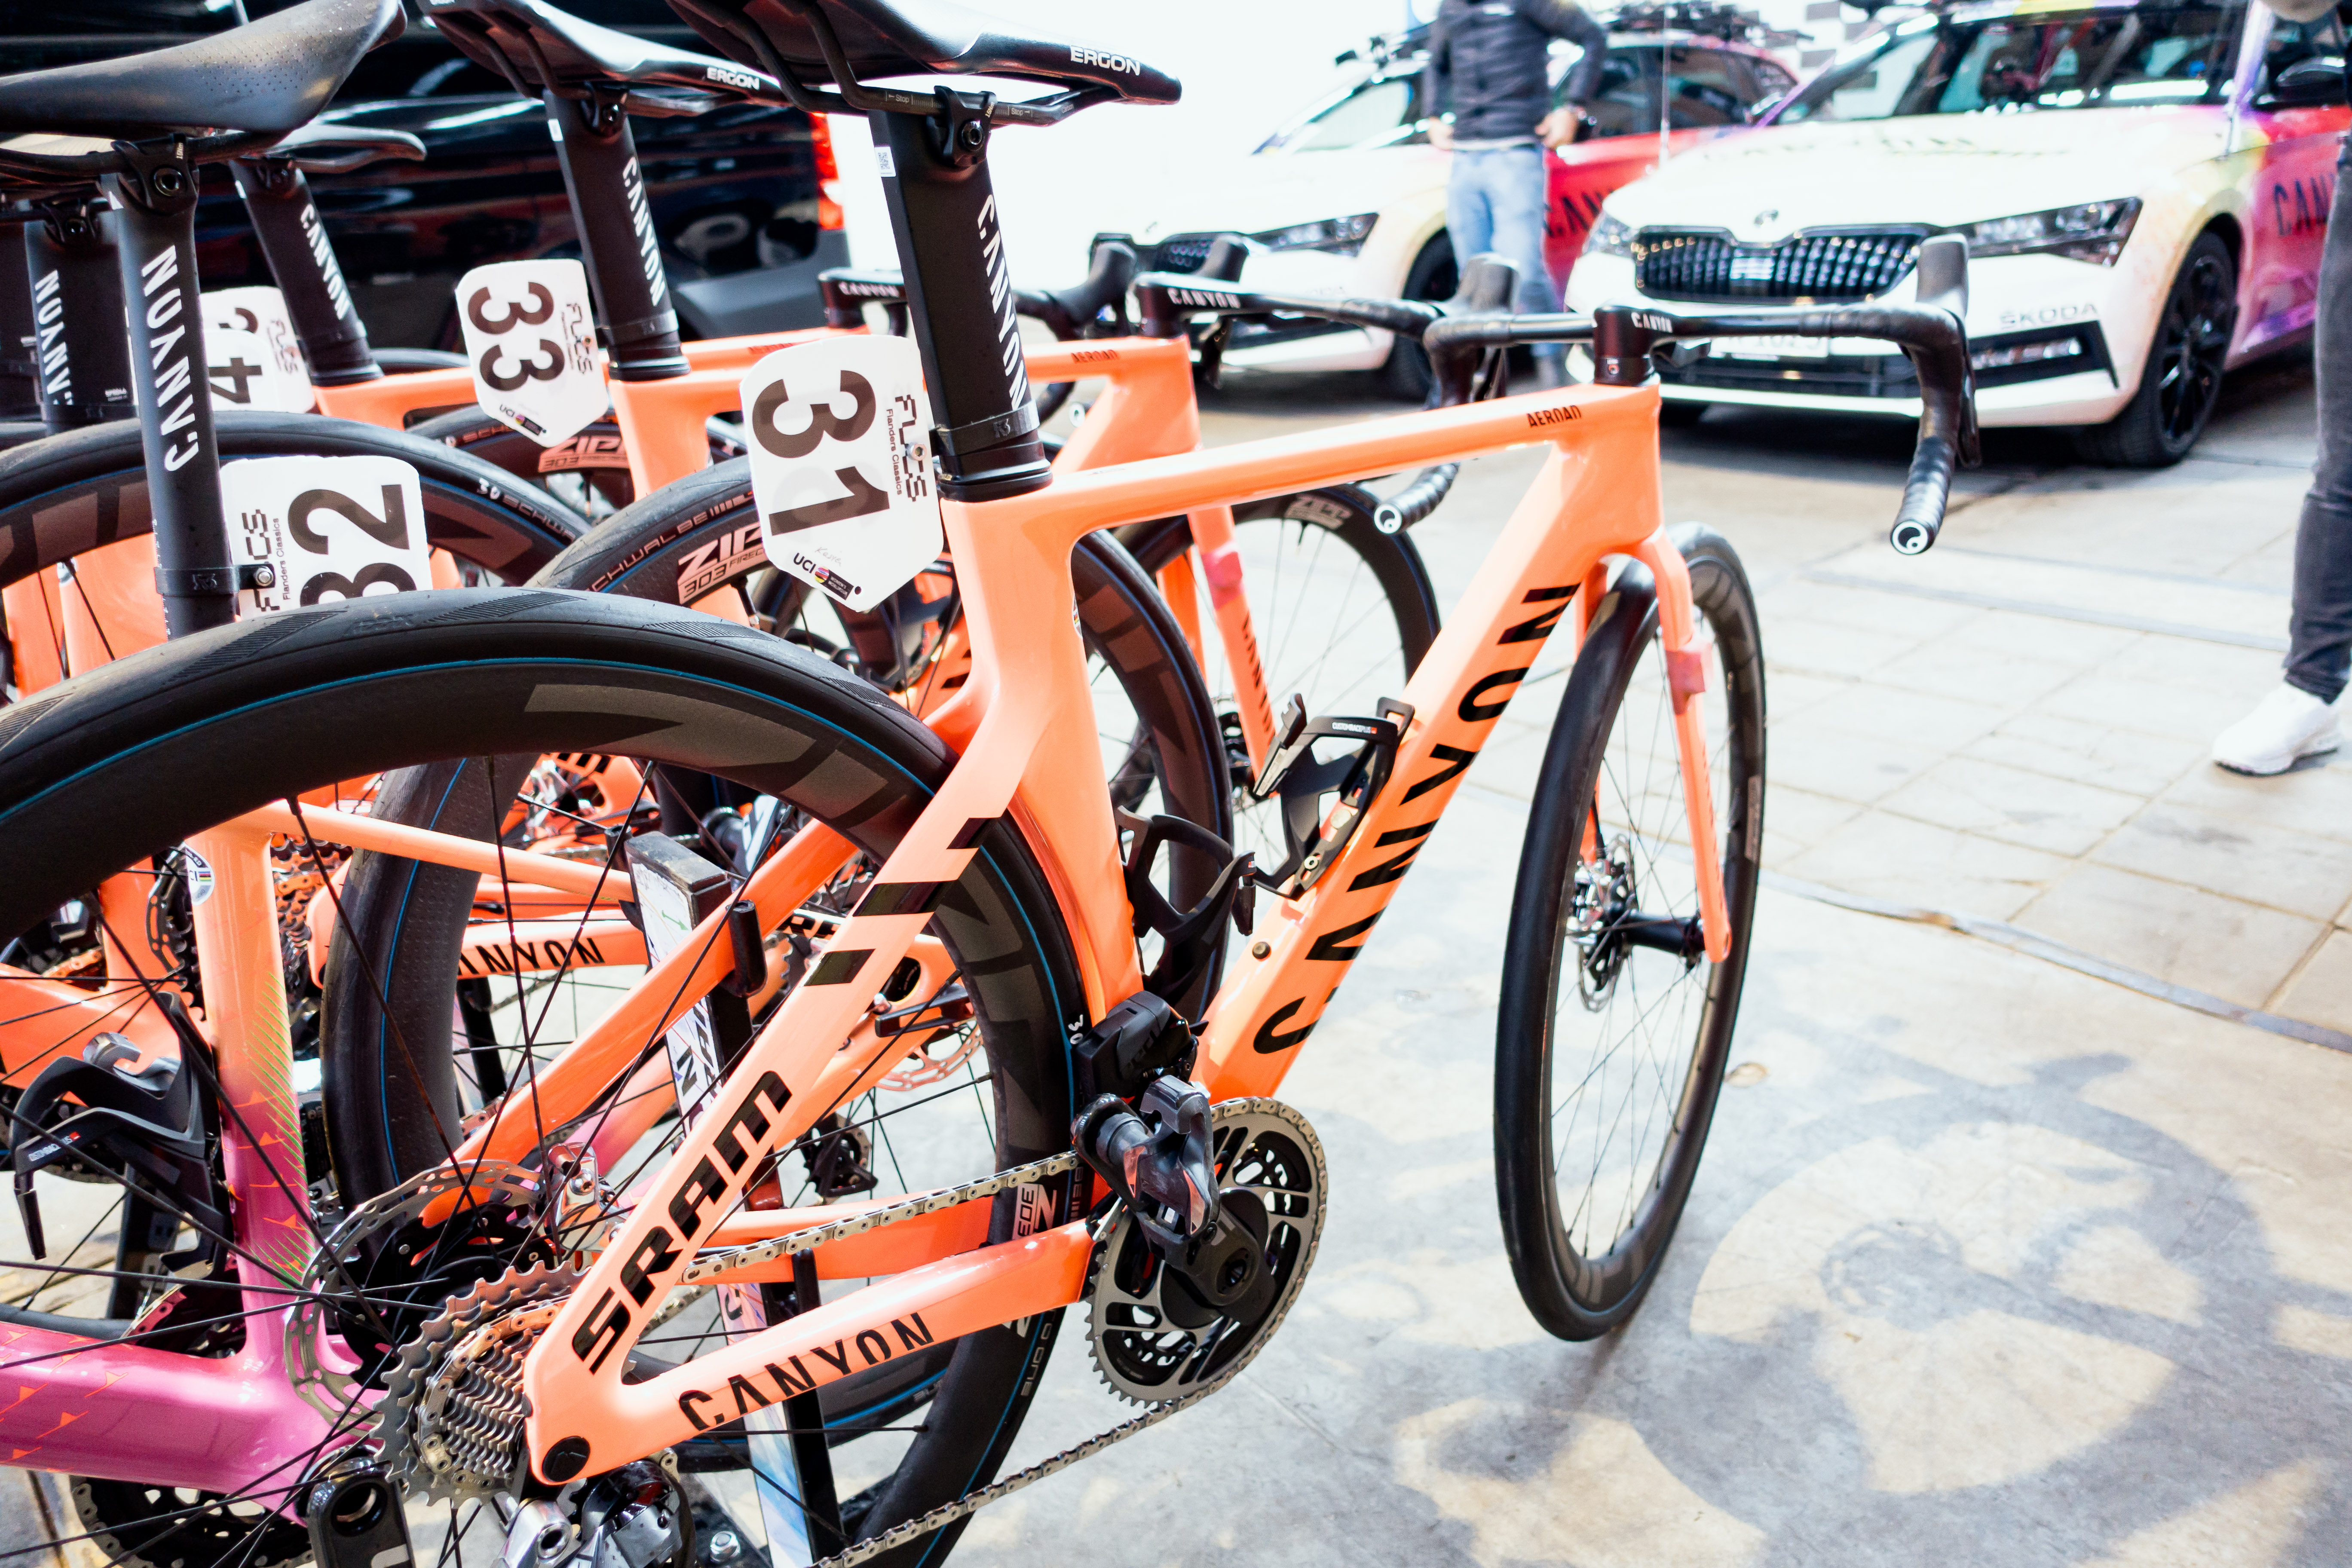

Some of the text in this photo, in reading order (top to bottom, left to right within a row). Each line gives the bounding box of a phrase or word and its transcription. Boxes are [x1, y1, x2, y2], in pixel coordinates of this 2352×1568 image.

[707, 67, 760, 89] ERGON
[1071, 46, 1140, 76] ERGON
[895, 94, 910, 103] Stop
[301, 204, 351, 321] CANYON
[622, 156, 666, 307] CANYON
[977, 194, 1028, 411] CANYON
[1167, 288, 1240, 309] CANYON
[1631, 312, 1673, 334] CANYON
[35, 270, 74, 405] ANYON
[142, 245, 199, 472] CANYON
[467, 282, 565, 392] 33
[1071, 349, 1118, 364] AEROAD
[551, 435, 627, 456] ZIP
[886, 408, 902, 495] Flanders Classics
[1526, 404, 1582, 429] AEROAD
[752, 370, 890, 536] 31
[288, 484, 418, 607] 32
[503, 494, 576, 542] SCHWA
[588, 511, 709, 592] CHWALBE
[678, 521, 762, 584] ZIP
[273, 518, 291, 600] Flanders Classics
[684, 547, 764, 599] 303 FIREC
[793, 552, 816, 573] UCI
[1252, 582, 1581, 1054] CANYON
[458, 937, 605, 976] ANYON
[572, 1070, 793, 1375] SRAM
[1018, 1188, 1035, 1238] 303
[678, 1311, 934, 1431] CANYON
